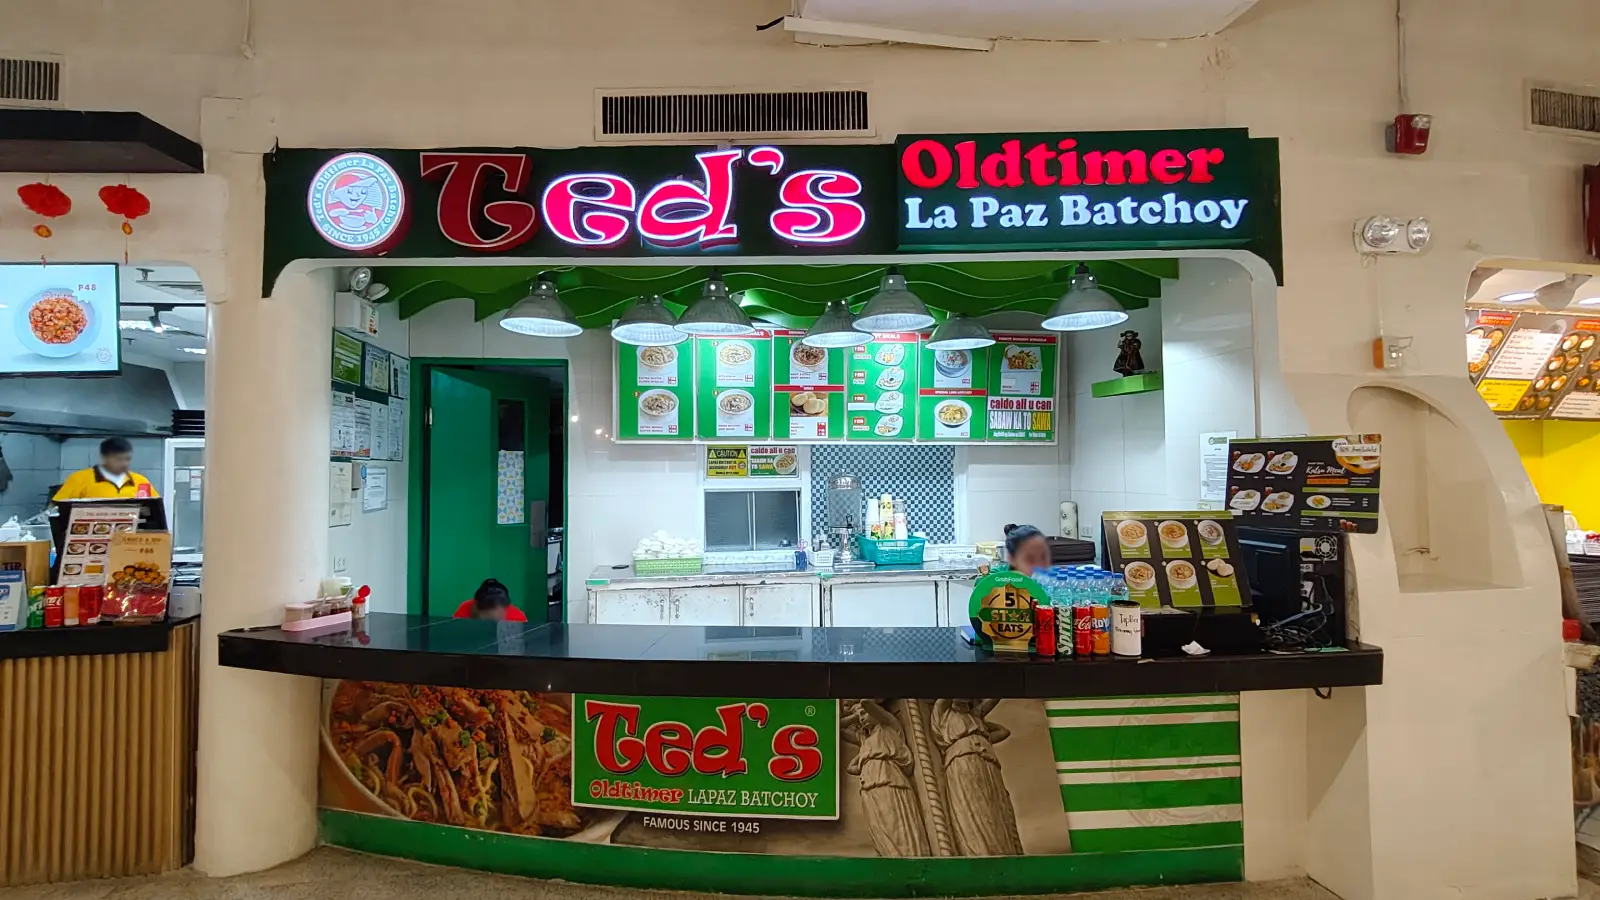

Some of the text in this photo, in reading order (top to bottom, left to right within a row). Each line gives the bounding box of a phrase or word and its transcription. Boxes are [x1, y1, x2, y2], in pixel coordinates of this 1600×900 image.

[361, 158, 374, 169] La
[901, 138, 1225, 189] Oldtimer
[316, 159, 360, 190] Oldtimer
[375, 166, 392, 184] Paz
[381, 184, 397, 229] Batchoy
[420, 147, 867, 249] Ted's
[904, 192, 1249, 229] La Paz Batchoy
[322, 223, 381, 243] SINCE 1945
[990, 398, 1051, 410] caldo all u can
[990, 411, 1051, 431] SABAW KA TO SAWA
[1005, 592, 1016, 607] 5
[997, 624, 1024, 633] EATS
[1057, 605, 1073, 656] Sprite
[1092, 618, 1109, 629] ROY
[584, 700, 823, 782] Ted's
[589, 779, 819, 809] Oldtimer LAPAZ BATCHOY
[643, 816, 760, 834] FAMOUS SINCE 1945
